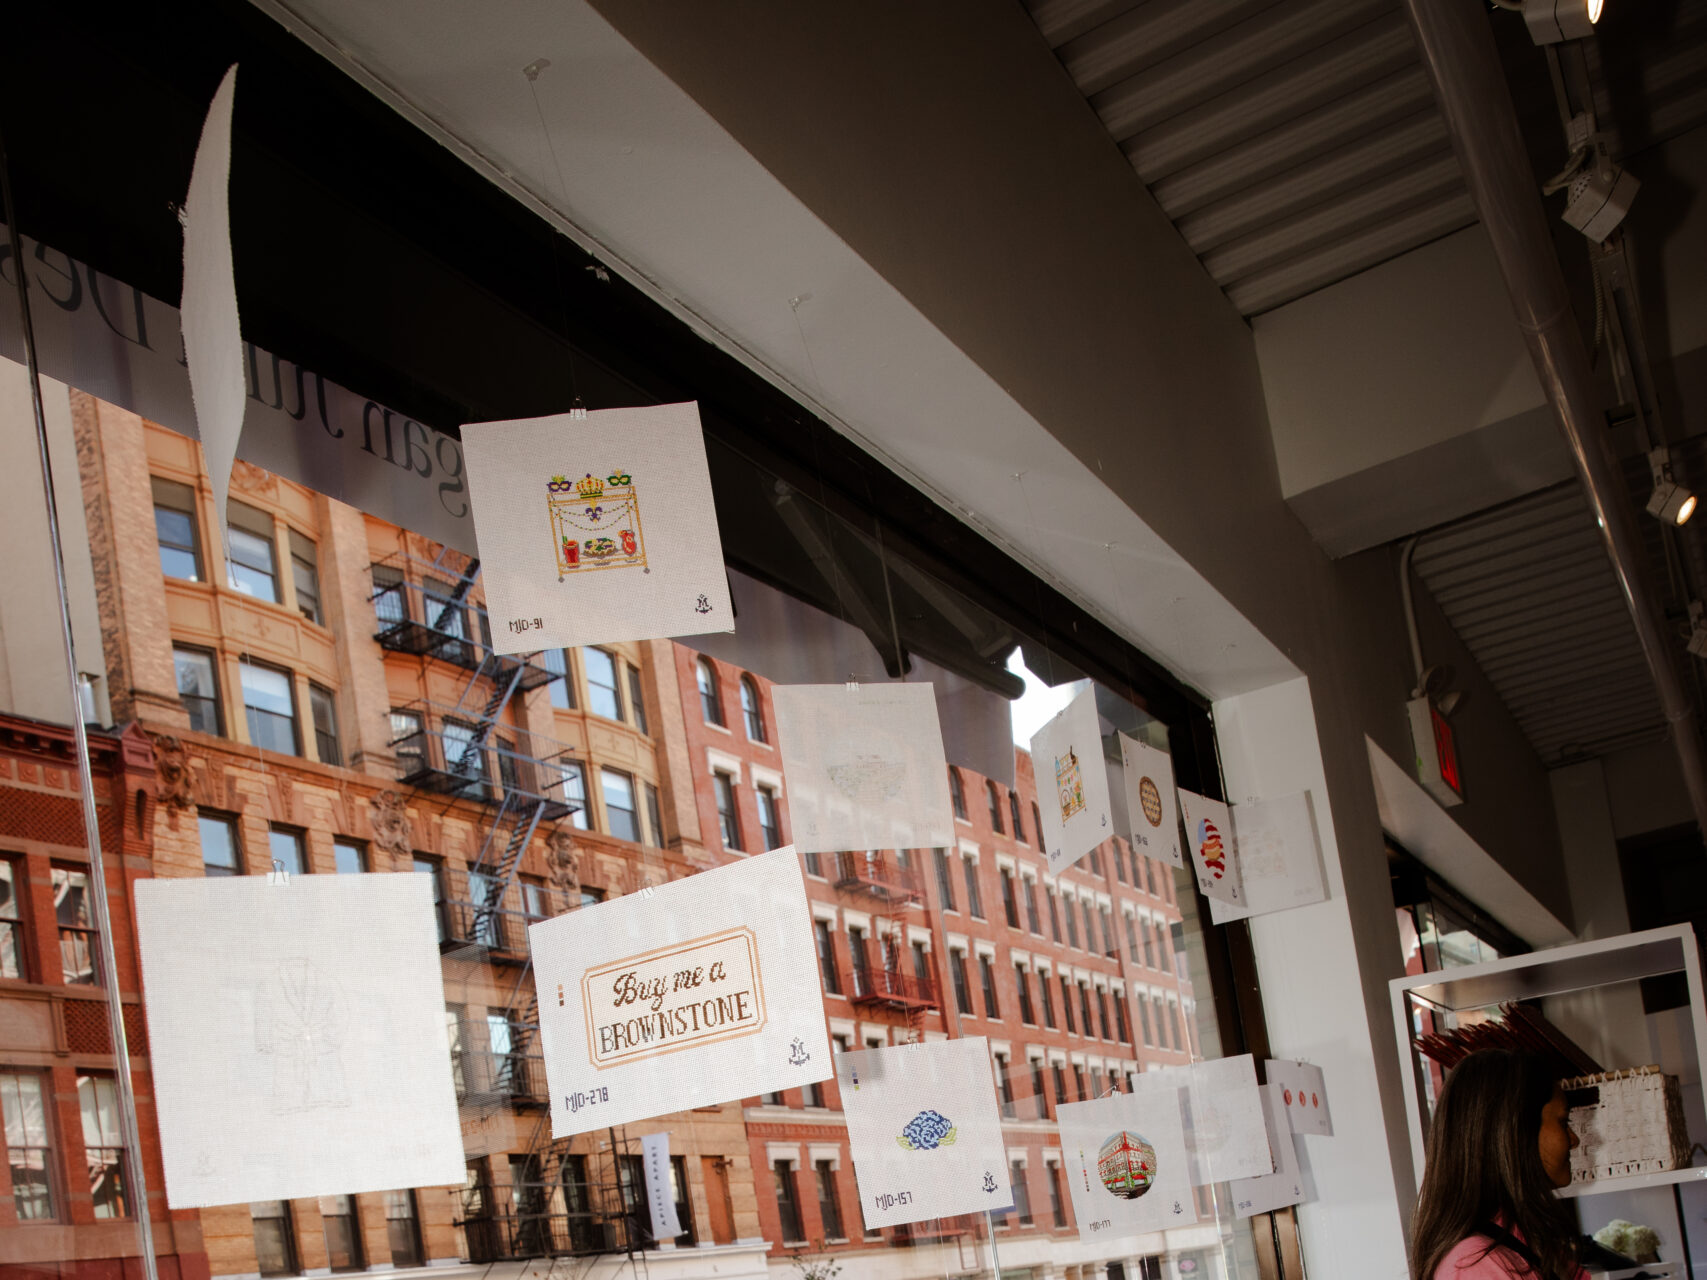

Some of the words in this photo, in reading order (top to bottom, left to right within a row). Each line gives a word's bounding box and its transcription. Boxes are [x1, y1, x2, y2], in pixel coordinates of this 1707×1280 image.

[508, 617, 544, 634] MJD-91
[612, 971, 669, 1012] Buy
[672, 964, 705, 993] me
[709, 961, 727, 983] a
[598, 990, 753, 1054] BROWNSTONE
[565, 1086, 609, 1113] MJD-278
[875, 1191, 913, 1211] MJD-157
